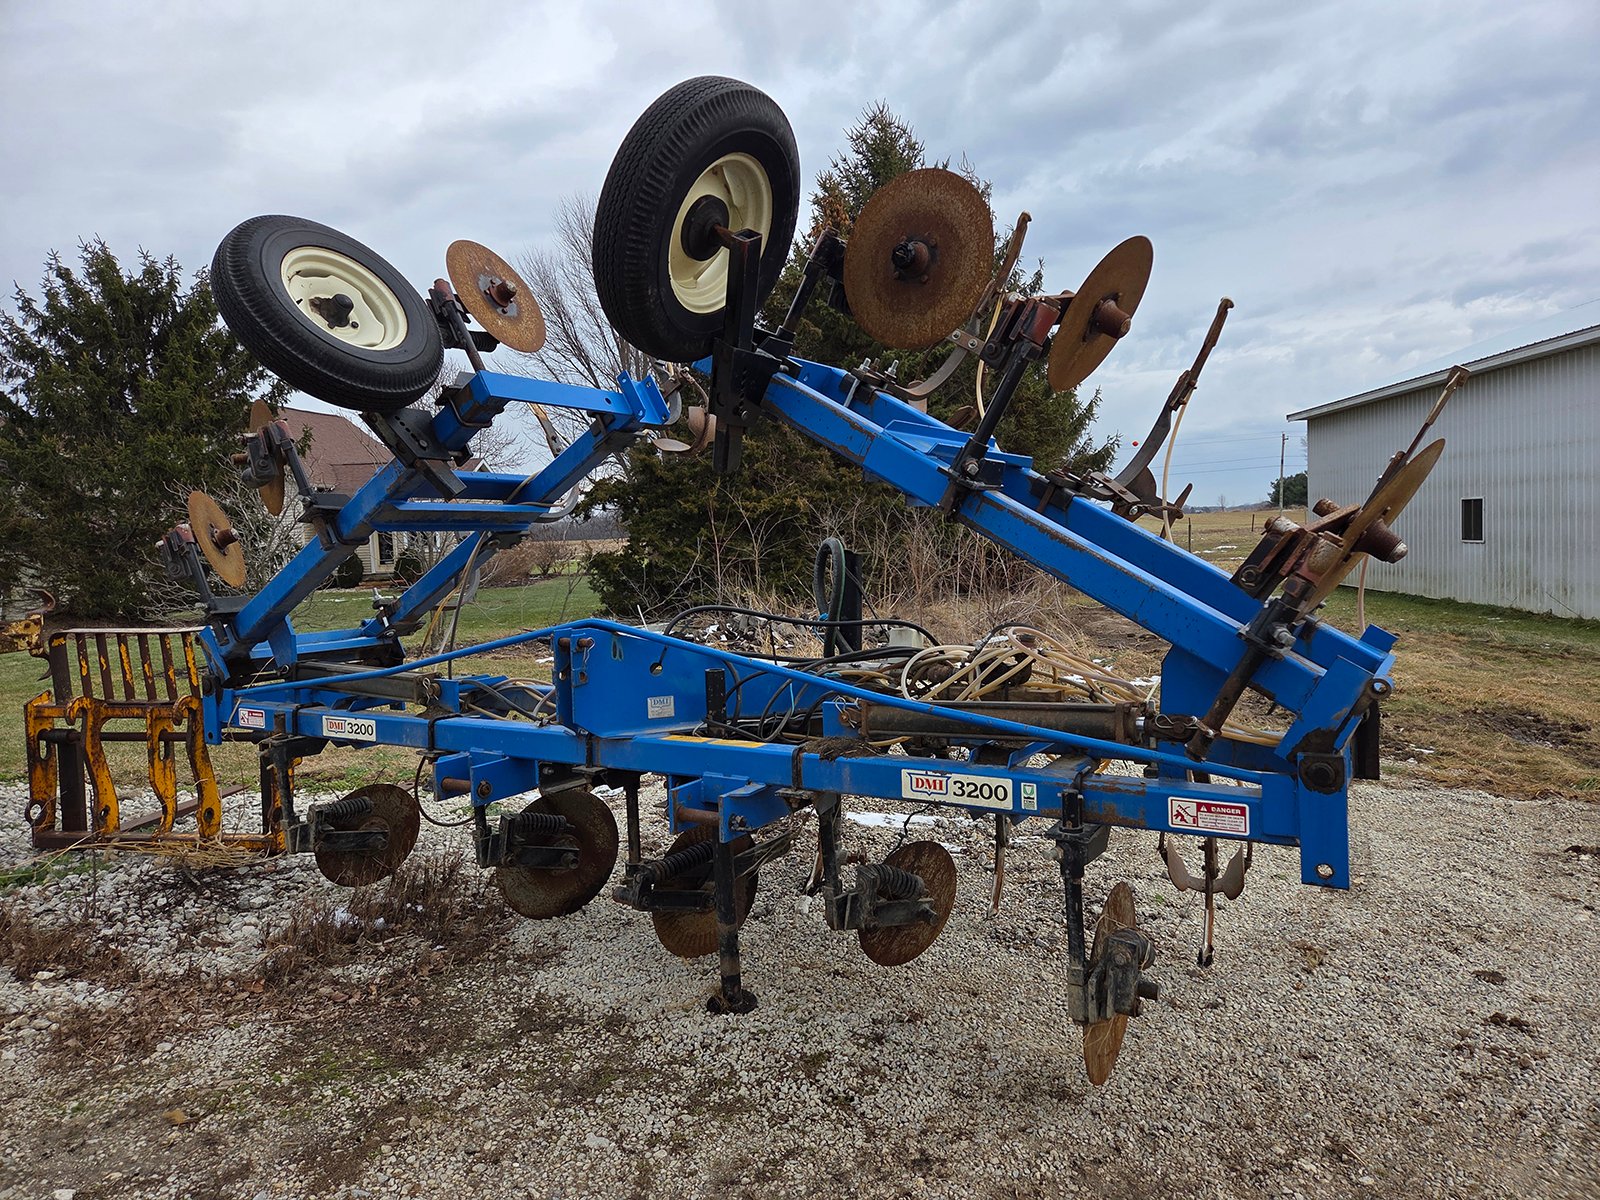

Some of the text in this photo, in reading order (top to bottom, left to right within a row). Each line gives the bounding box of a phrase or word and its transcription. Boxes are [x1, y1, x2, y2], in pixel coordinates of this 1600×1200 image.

[653, 698, 669, 706] DMI
[329, 721, 374, 736] DMI 3200
[915, 777, 1009, 802] DMI 3200
[1211, 806, 1241, 815] DANGER
